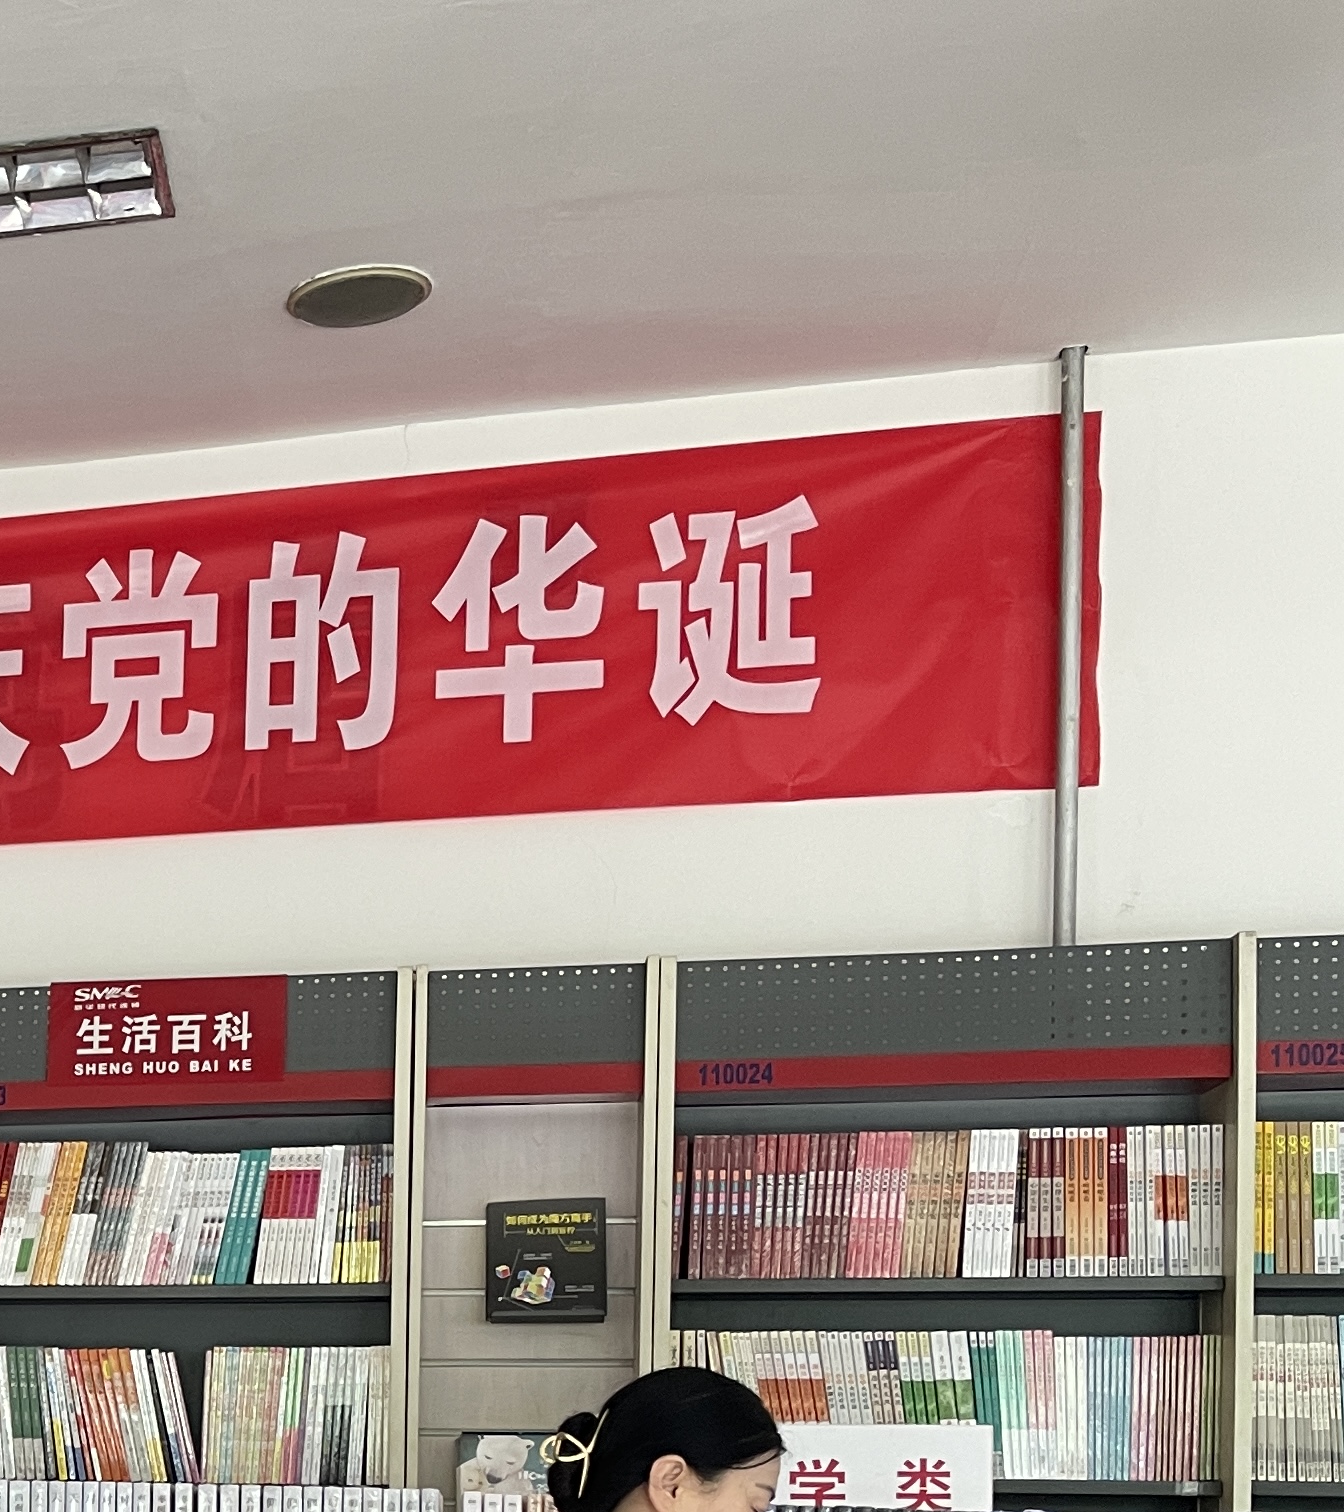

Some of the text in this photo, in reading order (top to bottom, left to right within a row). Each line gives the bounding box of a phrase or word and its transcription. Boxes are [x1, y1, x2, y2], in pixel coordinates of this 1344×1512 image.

[76, 1010, 254, 1056] 生活百科
[73, 1058, 253, 1077] SHENG HUO BAI KE
[1270, 1041, 1344, 1070] 11002
[698, 1060, 774, 1088] 110024
